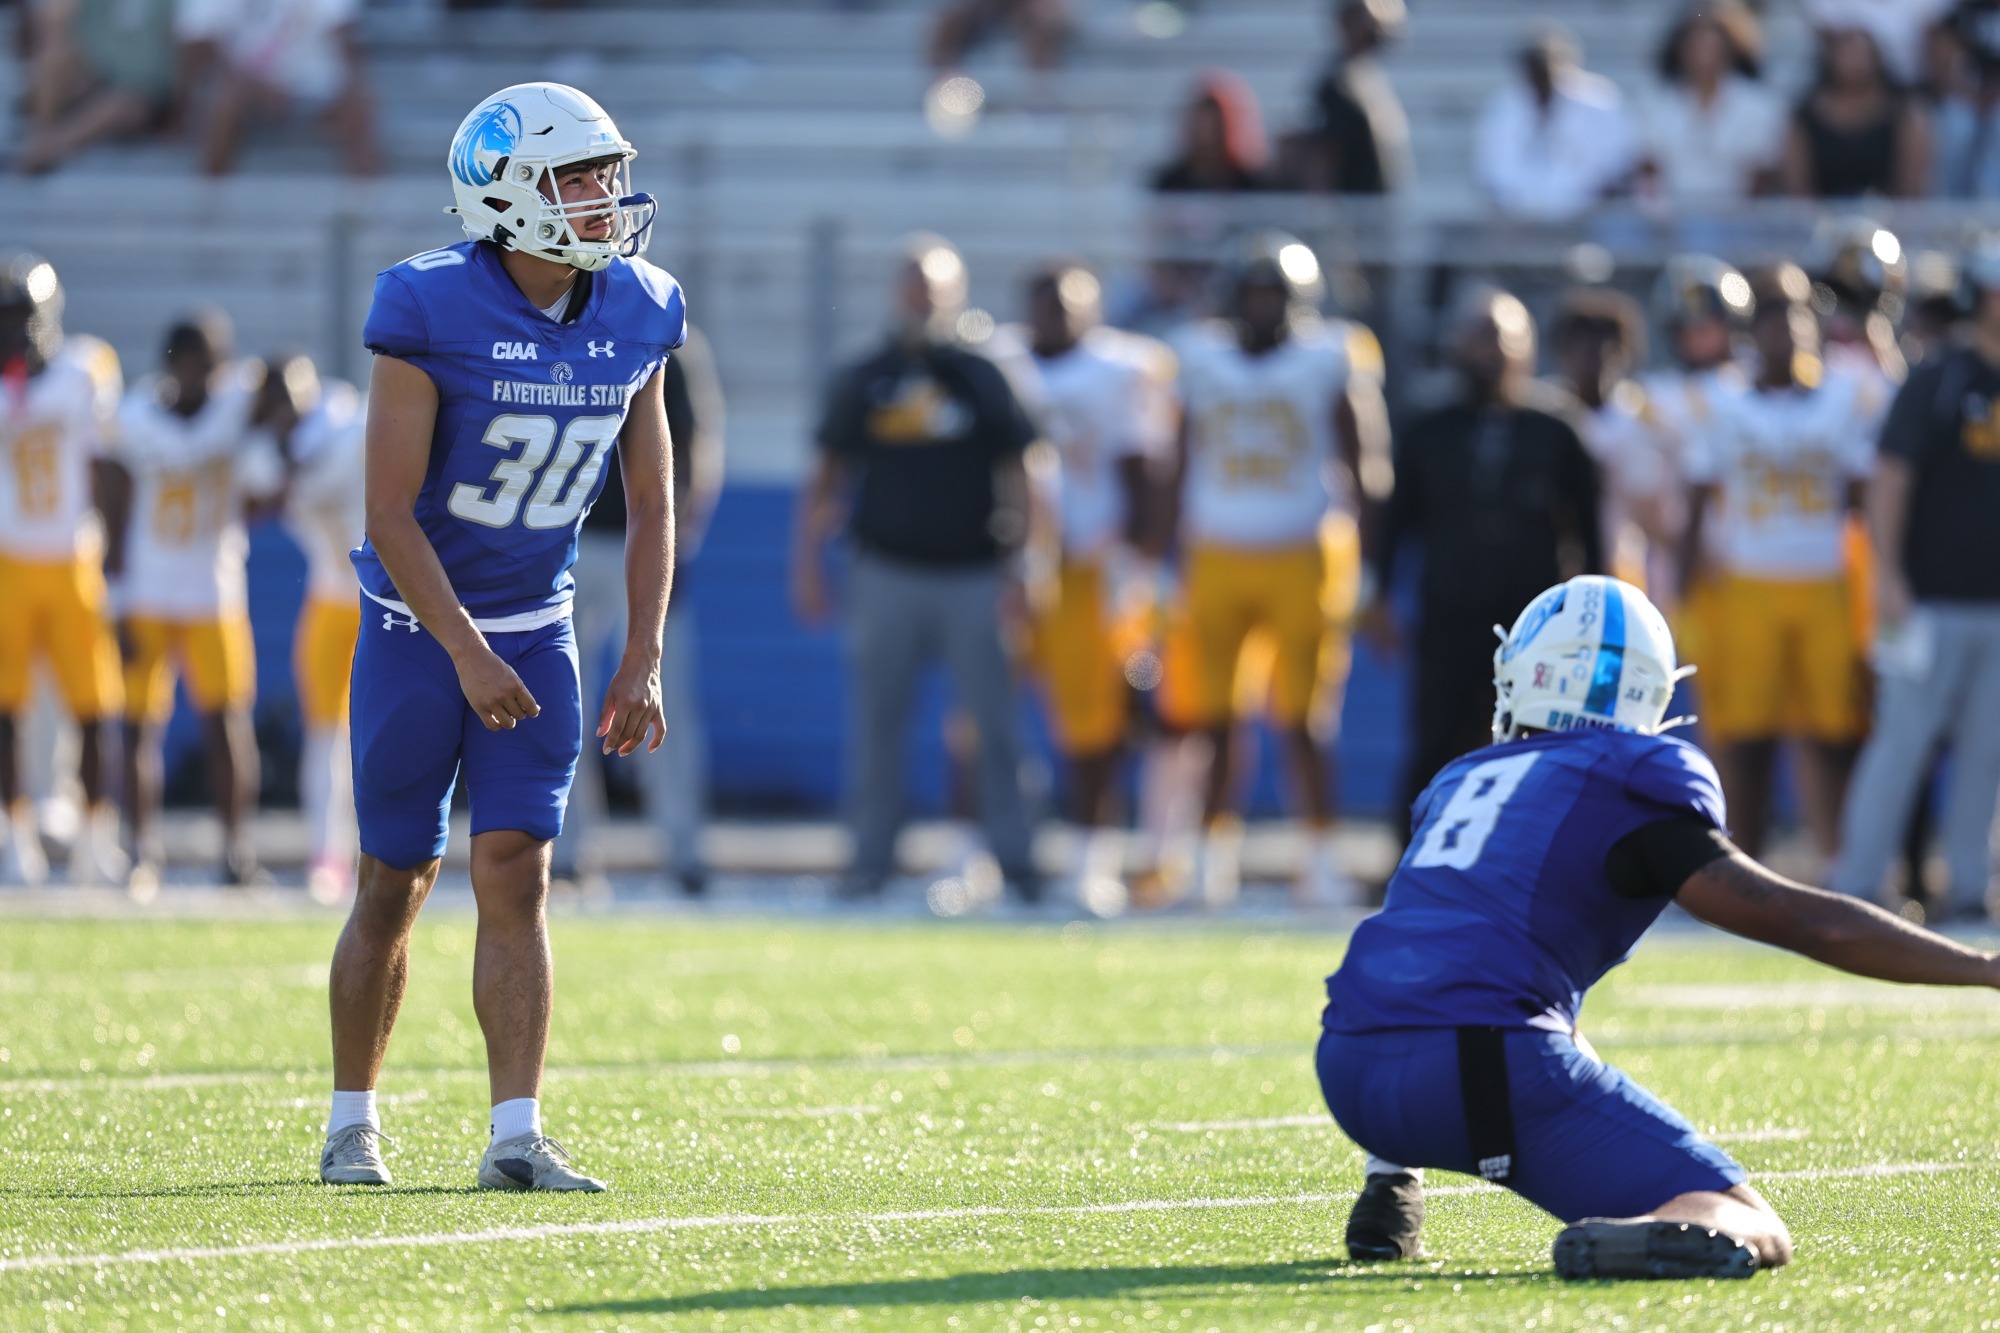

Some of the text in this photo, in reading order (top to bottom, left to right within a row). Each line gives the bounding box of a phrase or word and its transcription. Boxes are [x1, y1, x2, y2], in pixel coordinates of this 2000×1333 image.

[492, 341, 538, 360] CIAA
[492, 380, 586, 406] FAYETTEVILLE
[447, 413, 621, 530] 30
[1411, 750, 1542, 871] 8
